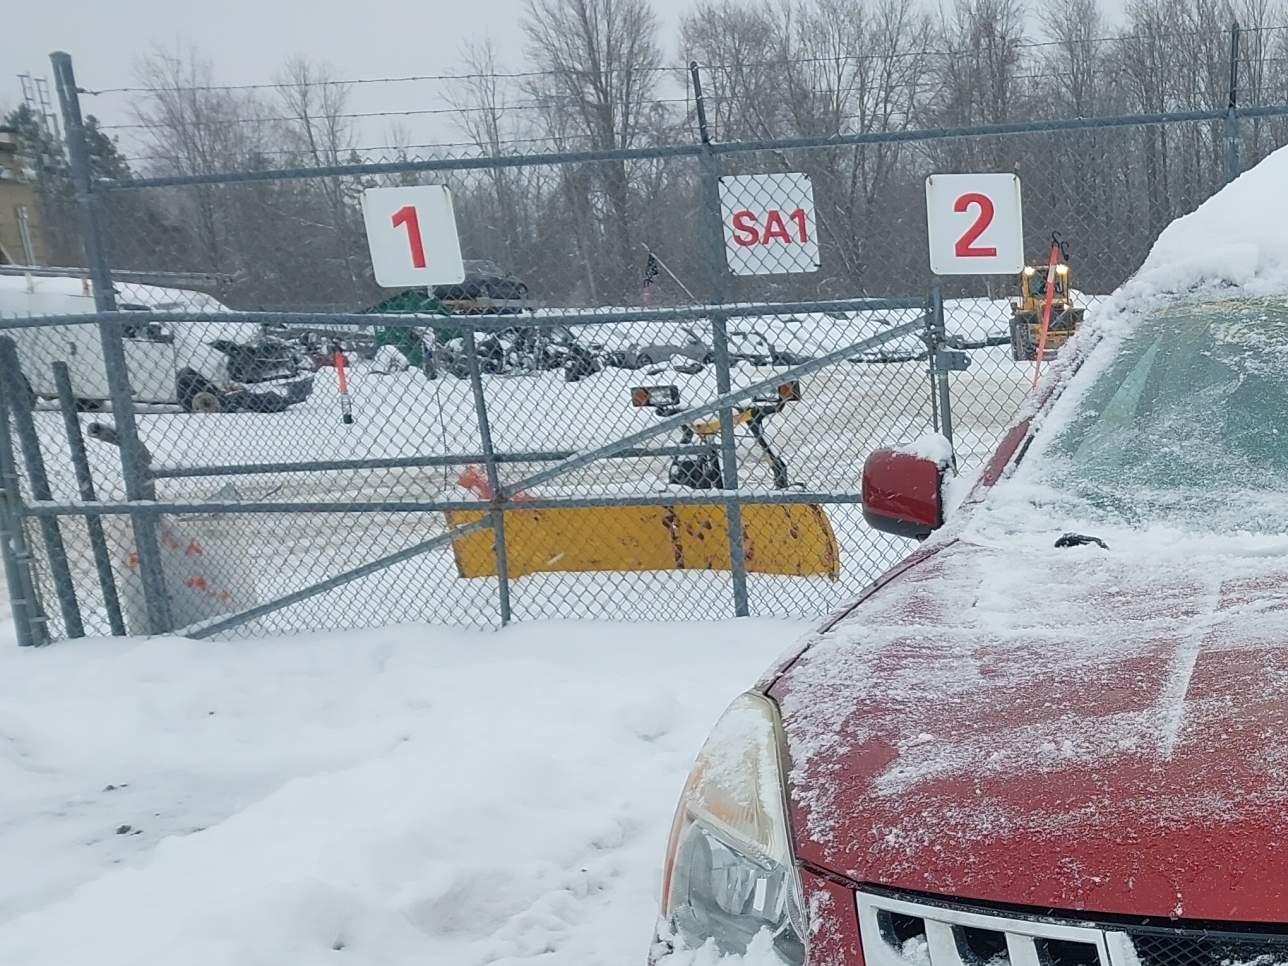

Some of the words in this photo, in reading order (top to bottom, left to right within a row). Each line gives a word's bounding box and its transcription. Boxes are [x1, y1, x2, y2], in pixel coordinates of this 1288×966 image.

[391, 205, 426, 269] 1
[732, 209, 808, 247] SA1
[953, 192, 998, 258] 2
